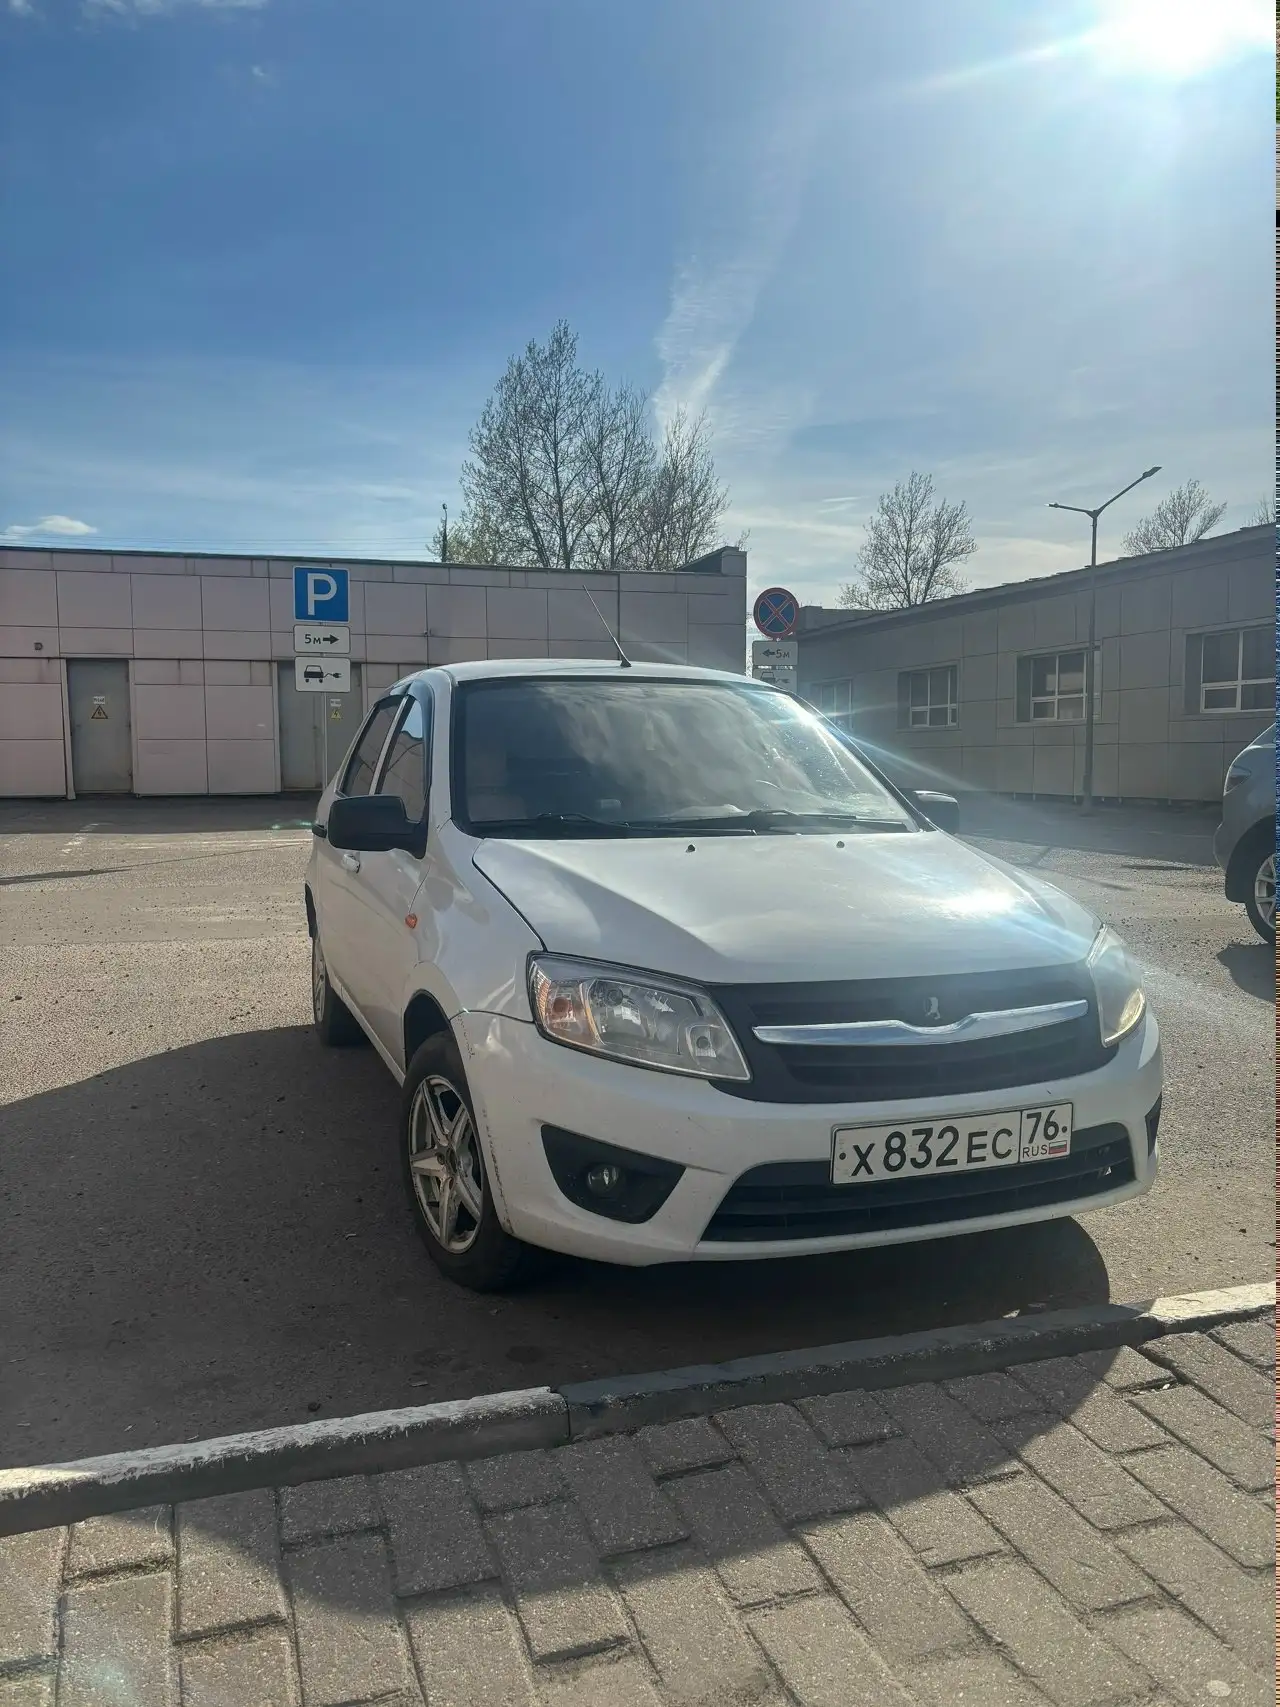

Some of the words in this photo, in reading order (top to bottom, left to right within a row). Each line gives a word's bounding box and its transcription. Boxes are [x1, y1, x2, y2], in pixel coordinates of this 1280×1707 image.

[307, 573, 337, 615] P
[1026, 1109, 1060, 1144] 76
[1022, 1144, 1048, 1159] RUS
